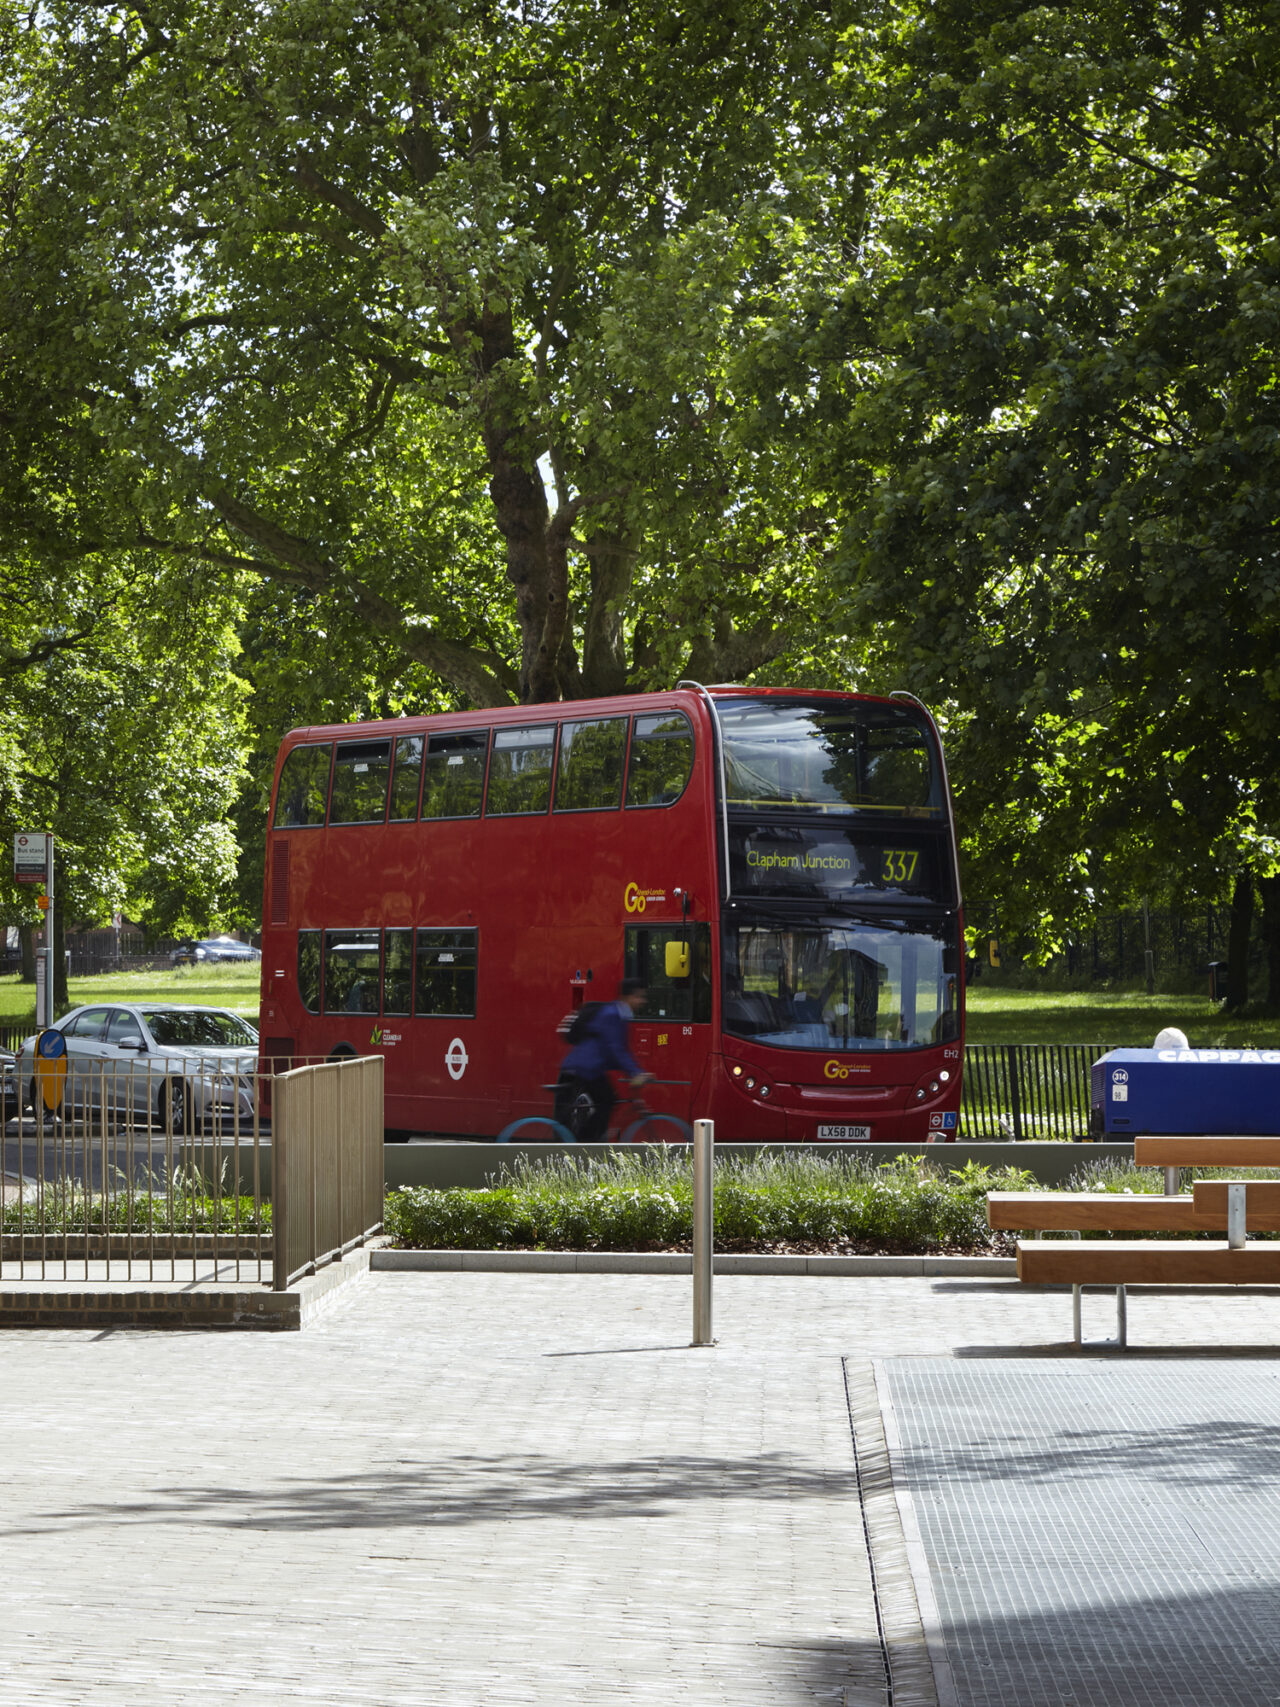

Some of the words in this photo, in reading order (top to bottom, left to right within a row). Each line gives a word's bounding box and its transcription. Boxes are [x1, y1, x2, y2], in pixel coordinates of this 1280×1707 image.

[746, 850, 799, 871] Clapham
[802, 852, 850, 869] Junction
[882, 850, 919, 882] 337
[944, 1050, 959, 1058] EH2
[1114, 1073, 1126, 1081] 314
[821, 1127, 846, 1137] LX58
[848, 1128, 867, 1138] DDK
